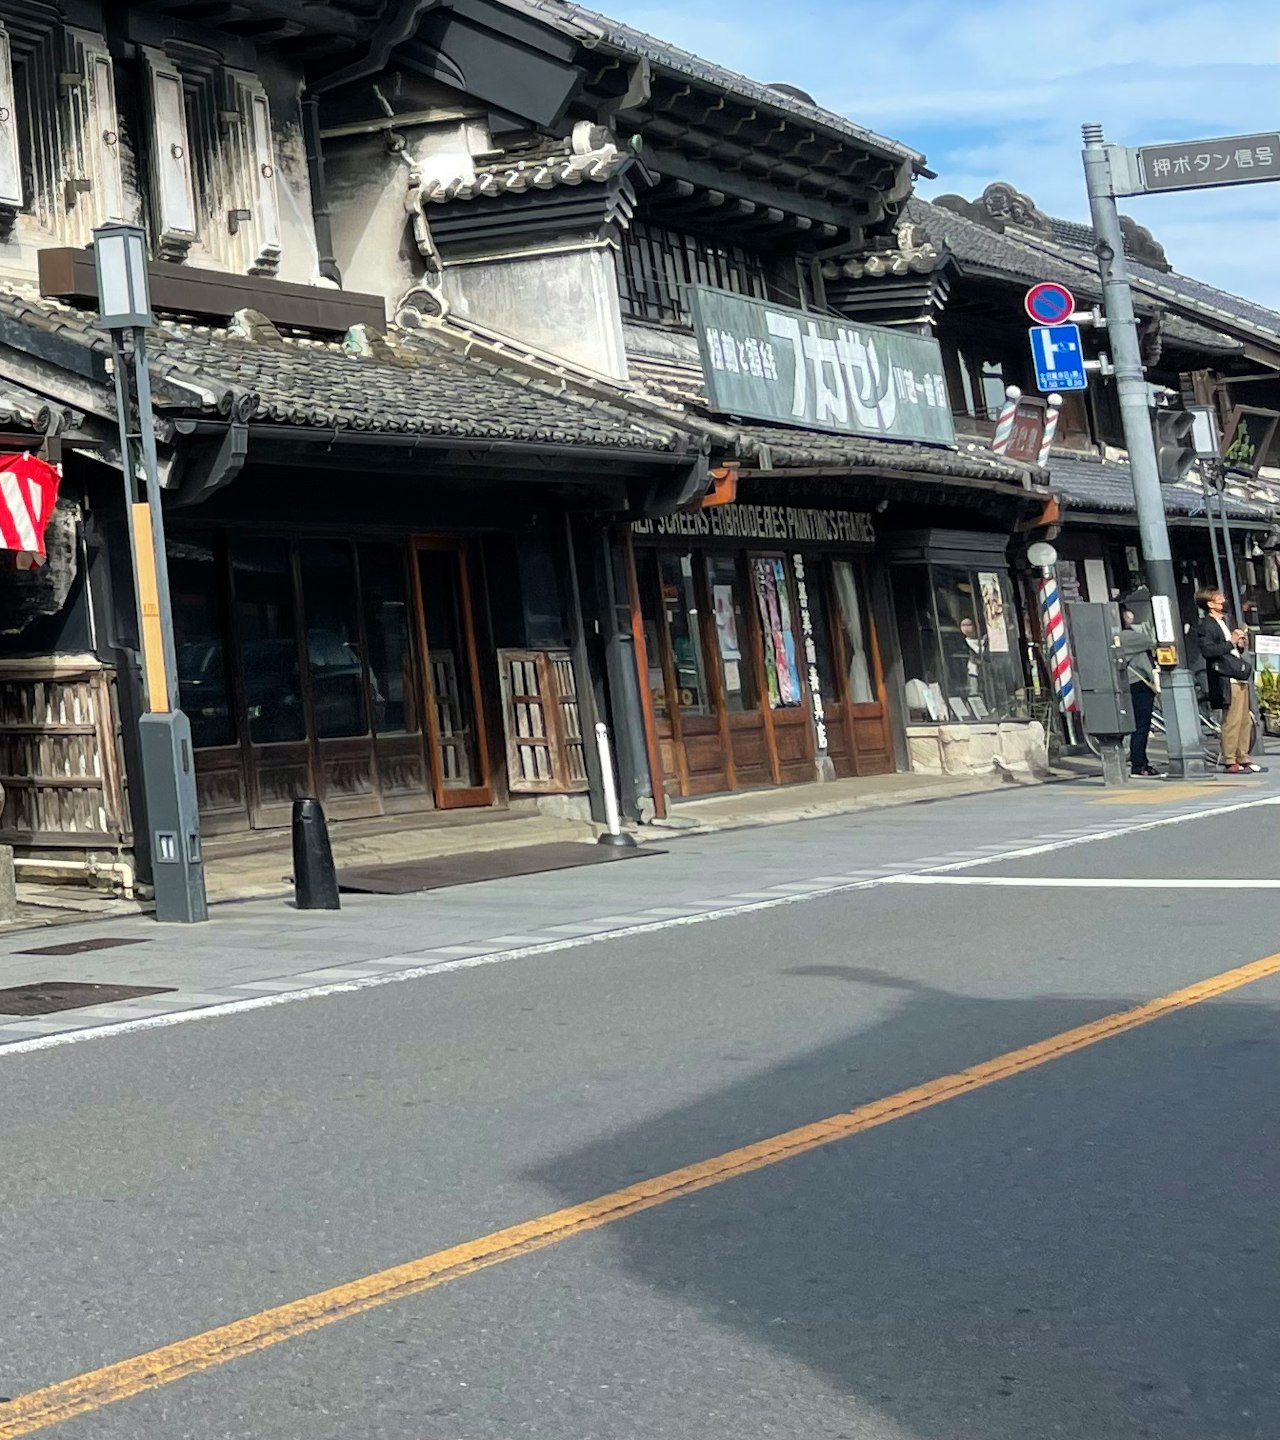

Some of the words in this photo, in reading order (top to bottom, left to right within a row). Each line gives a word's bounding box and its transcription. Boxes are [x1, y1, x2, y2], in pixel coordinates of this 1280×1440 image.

[1152, 146, 1274, 177] 押ボタン信号
